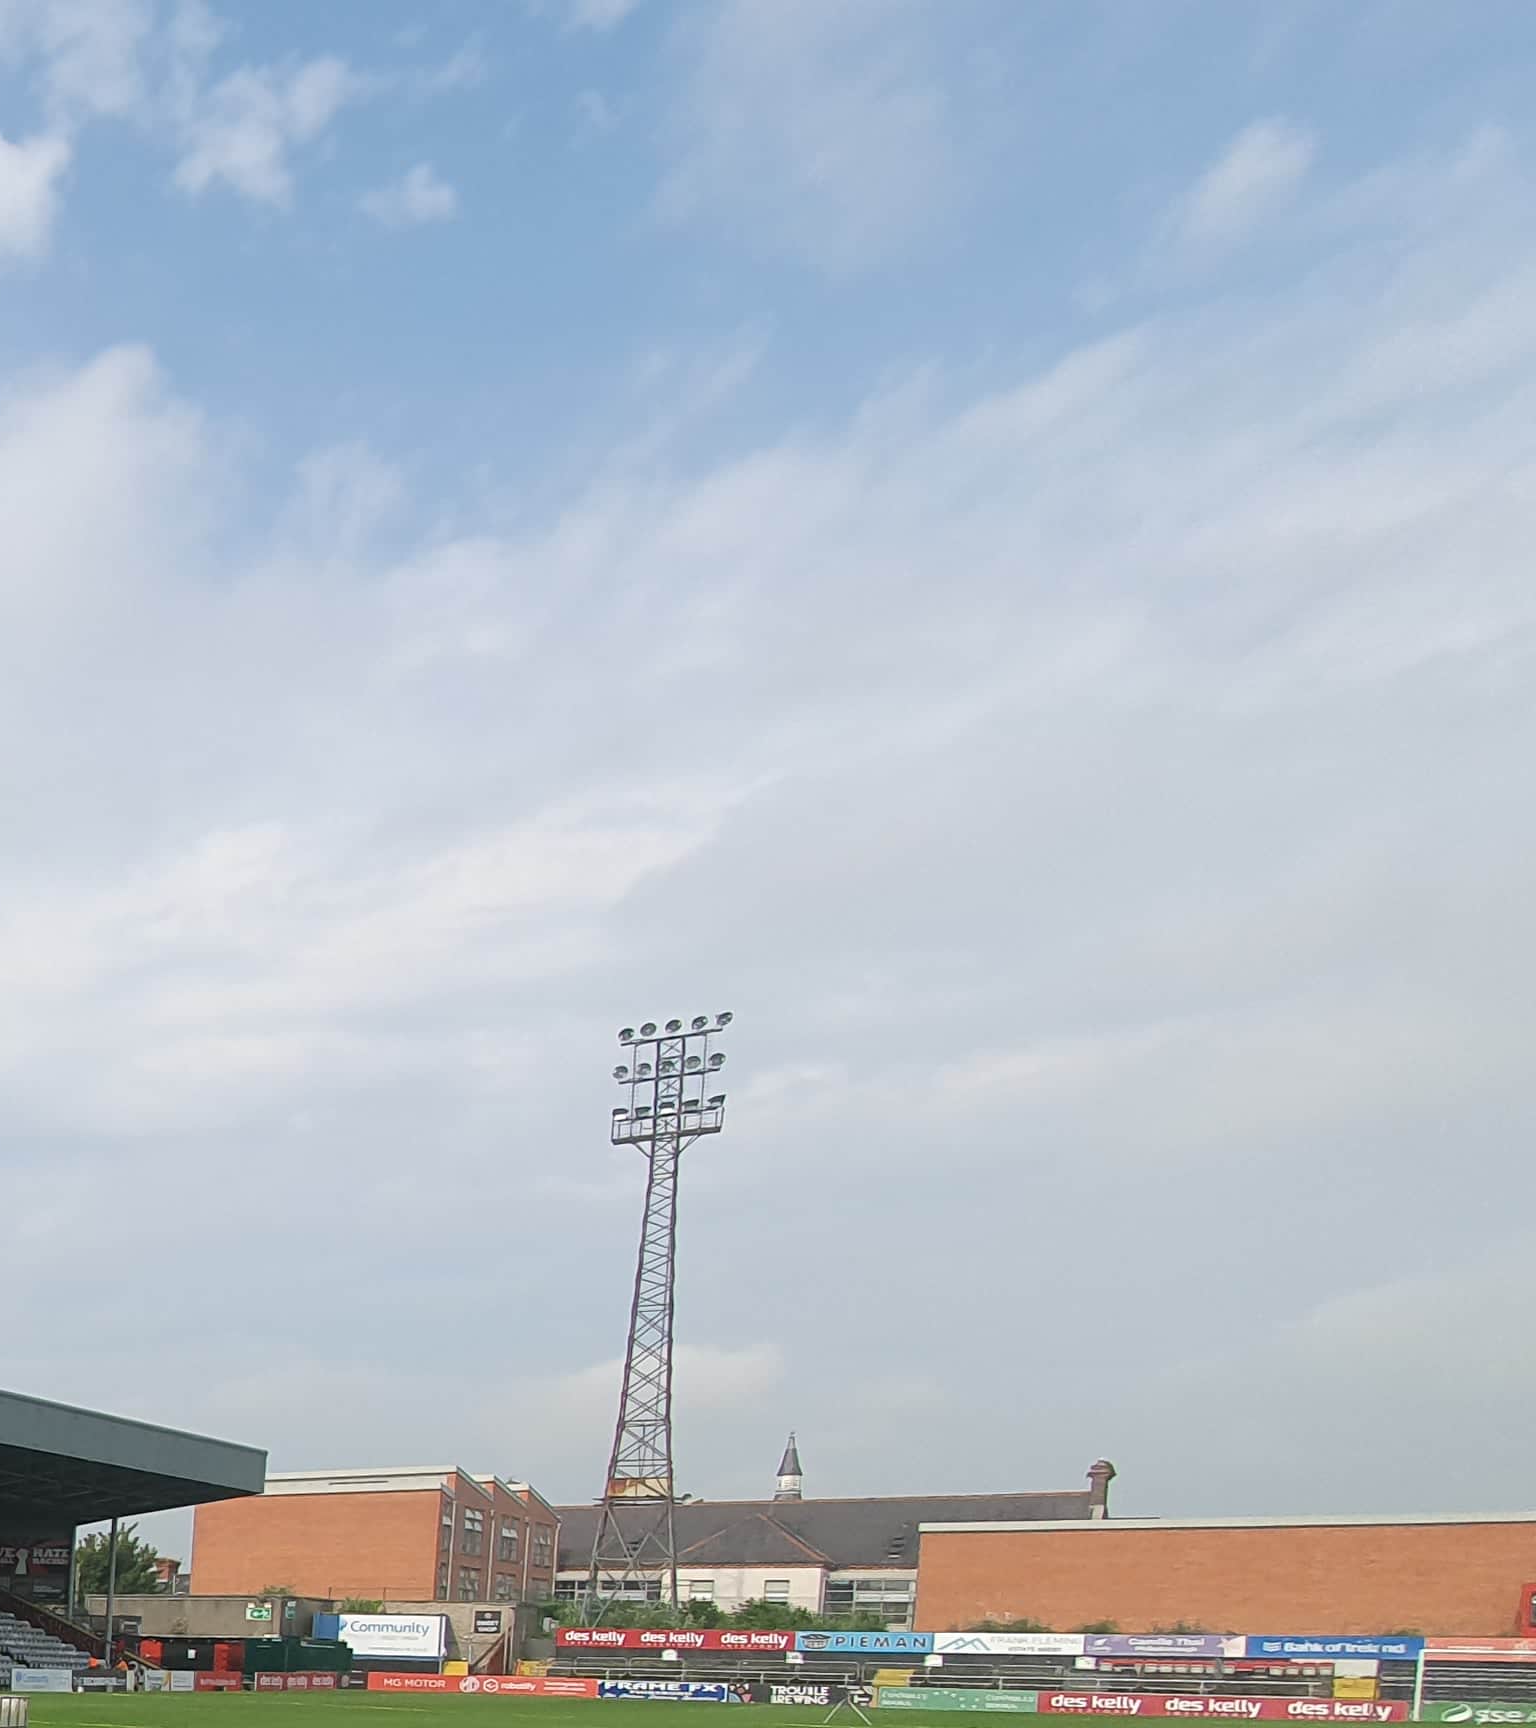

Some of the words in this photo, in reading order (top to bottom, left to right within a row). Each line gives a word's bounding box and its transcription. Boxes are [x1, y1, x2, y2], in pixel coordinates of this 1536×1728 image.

[349, 1620, 431, 1637] Community
[564, 1630, 590, 1642] des
[591, 1631, 626, 1646] kelly
[640, 1631, 666, 1643] des
[669, 1631, 705, 1647] kelly
[720, 1632, 748, 1644] des
[750, 1632, 789, 1649] kelly
[834, 1635, 927, 1648] PIEMAN
[383, 1678, 402, 1688] MG
[404, 1678, 447, 1689] MOTOR
[603, 1681, 680, 1691] FRAME
[688, 1683, 718, 1693] FX
[1050, 1694, 1087, 1709] des
[1091, 1695, 1142, 1715] kelly
[1164, 1698, 1205, 1712] des
[1208, 1698, 1262, 1718] kelly
[1287, 1701, 1329, 1715] des
